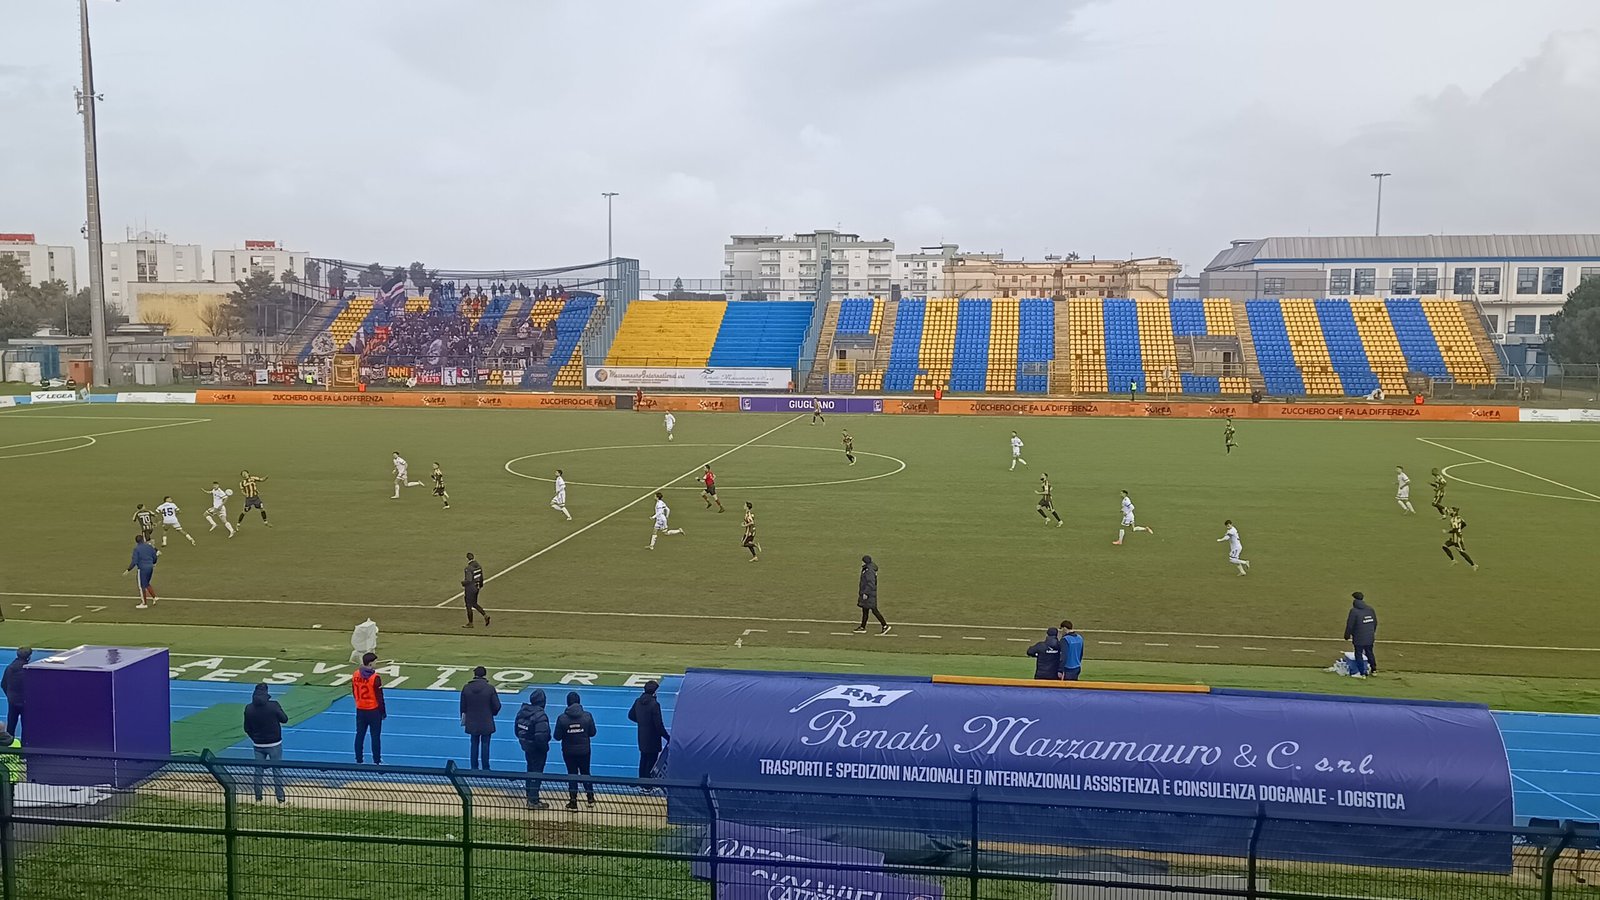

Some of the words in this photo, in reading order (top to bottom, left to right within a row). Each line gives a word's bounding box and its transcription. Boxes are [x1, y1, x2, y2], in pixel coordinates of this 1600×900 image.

[273, 393, 308, 401] ZUCCHERO
[309, 394, 323, 402] CHE
[343, 395, 384, 403] DIFFERENZA
[578, 398, 593, 406] CHE
[788, 400, 835, 409] GIUGLANO
[970, 403, 1011, 411] ZUCCHERO
[1012, 404, 1028, 412] CHE
[1029, 404, 1039, 412] FA
[1040, 404, 1051, 412] LA
[1051, 404, 1099, 412] DIFFERENZA
[1281, 407, 1325, 415] ZUCCHERO
[1327, 407, 1343, 415] CHE
[1345, 408, 1356, 416] FA
[1357, 408, 1367, 416] LA
[1369, 408, 1421, 416] DIFFERENZA
[161, 507, 174, 517] 45
[354, 684, 371, 701] 12
[841, 687, 887, 704] RM
[801, 709, 941, 751] Renato
[953, 715, 1222, 766] Mazzamauro
[1233, 743, 1257, 768] &
[1266, 741, 1302, 770] C.
[1314, 754, 1375, 775] s.r.l.
[759, 758, 823, 777] TRASPORTI
[825, 762, 833, 777] E
[835, 762, 900, 781] SPEDIZIONI
[903, 766, 964, 785] NAZIONALI
[966, 769, 982, 785] ED
[985, 770, 1081, 790] INTERNAZIONALI
[1083, 775, 1160, 795] ASSISTENZA
[1162, 779, 1171, 795] E
[1173, 779, 1256, 800] CONSULENZA
[1259, 784, 1327, 805] DOGANALE
[1337, 789, 1406, 810] LOGISTICA
